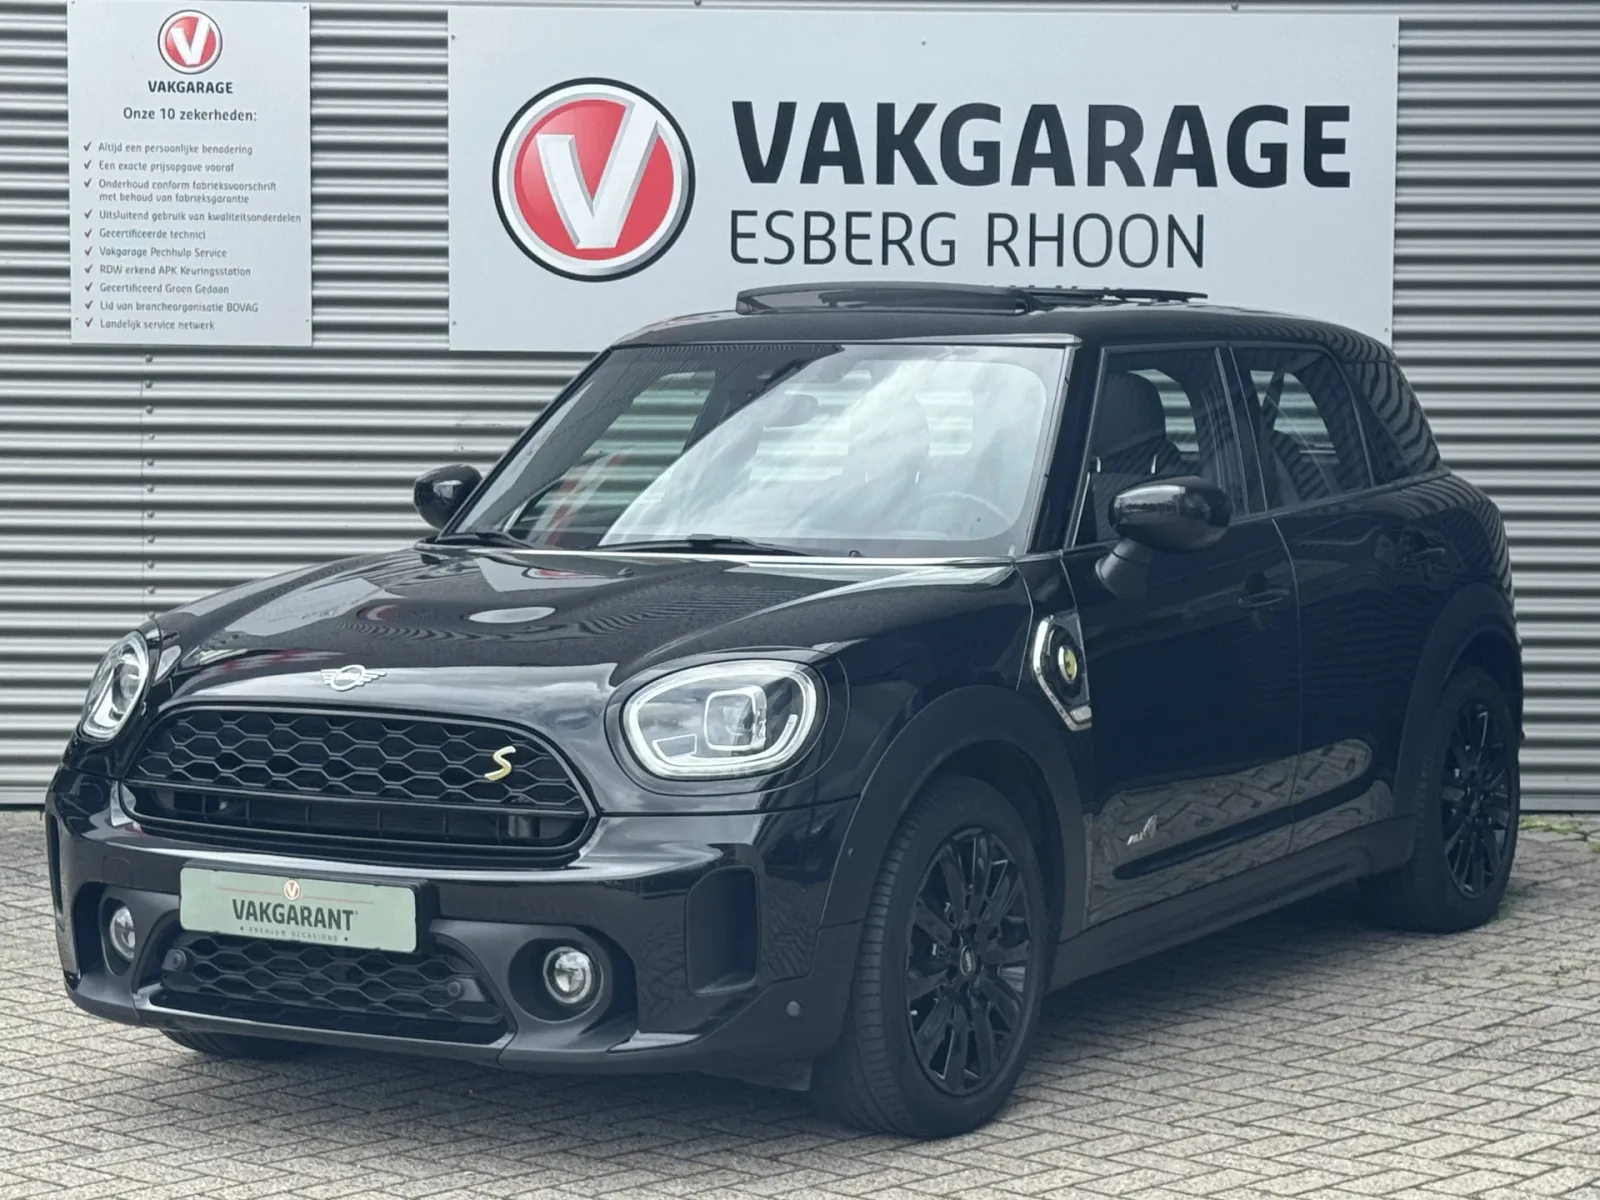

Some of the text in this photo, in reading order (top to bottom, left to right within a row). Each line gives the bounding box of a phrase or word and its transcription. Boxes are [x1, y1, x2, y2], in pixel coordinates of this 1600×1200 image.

[148, 80, 233, 94] VAKGARAGE
[123, 107, 257, 122] Onze 10 zekerheden:
[99, 143, 122, 153] Altijd
[145, 144, 199, 154] persoonlijke
[202, 145, 252, 155] benadering
[732, 101, 1351, 188] VAKGARAGE
[99, 161, 234, 173] Een exacte prijsopgave vooraf
[99, 180, 276, 191] Onderhoud conform fabrieksvoorschrift
[100, 193, 116, 202] met
[120, 193, 153, 202] behoud
[176, 195, 249, 205] fabrieksgarantie
[100, 211, 301, 222] Uitsluitend gebruik van kwaliteitsonderdelen
[100, 229, 205, 239] Gecertificeerde technici
[730, 210, 1204, 269] ESBERG RHOON
[100, 247, 227, 259] Vakgarage Pechhulp Service
[100, 265, 251, 276] RDW erkend APK Keuringsstation
[100, 283, 229, 293] Gecertificeerd Groen Gedaan
[100, 302, 258, 313] Lid van brancheorganisatie BOVAG
[100, 319, 214, 330] Landelijk service netwerk
[484, 746, 516, 781] S
[232, 899, 354, 931] VAKGARANT
